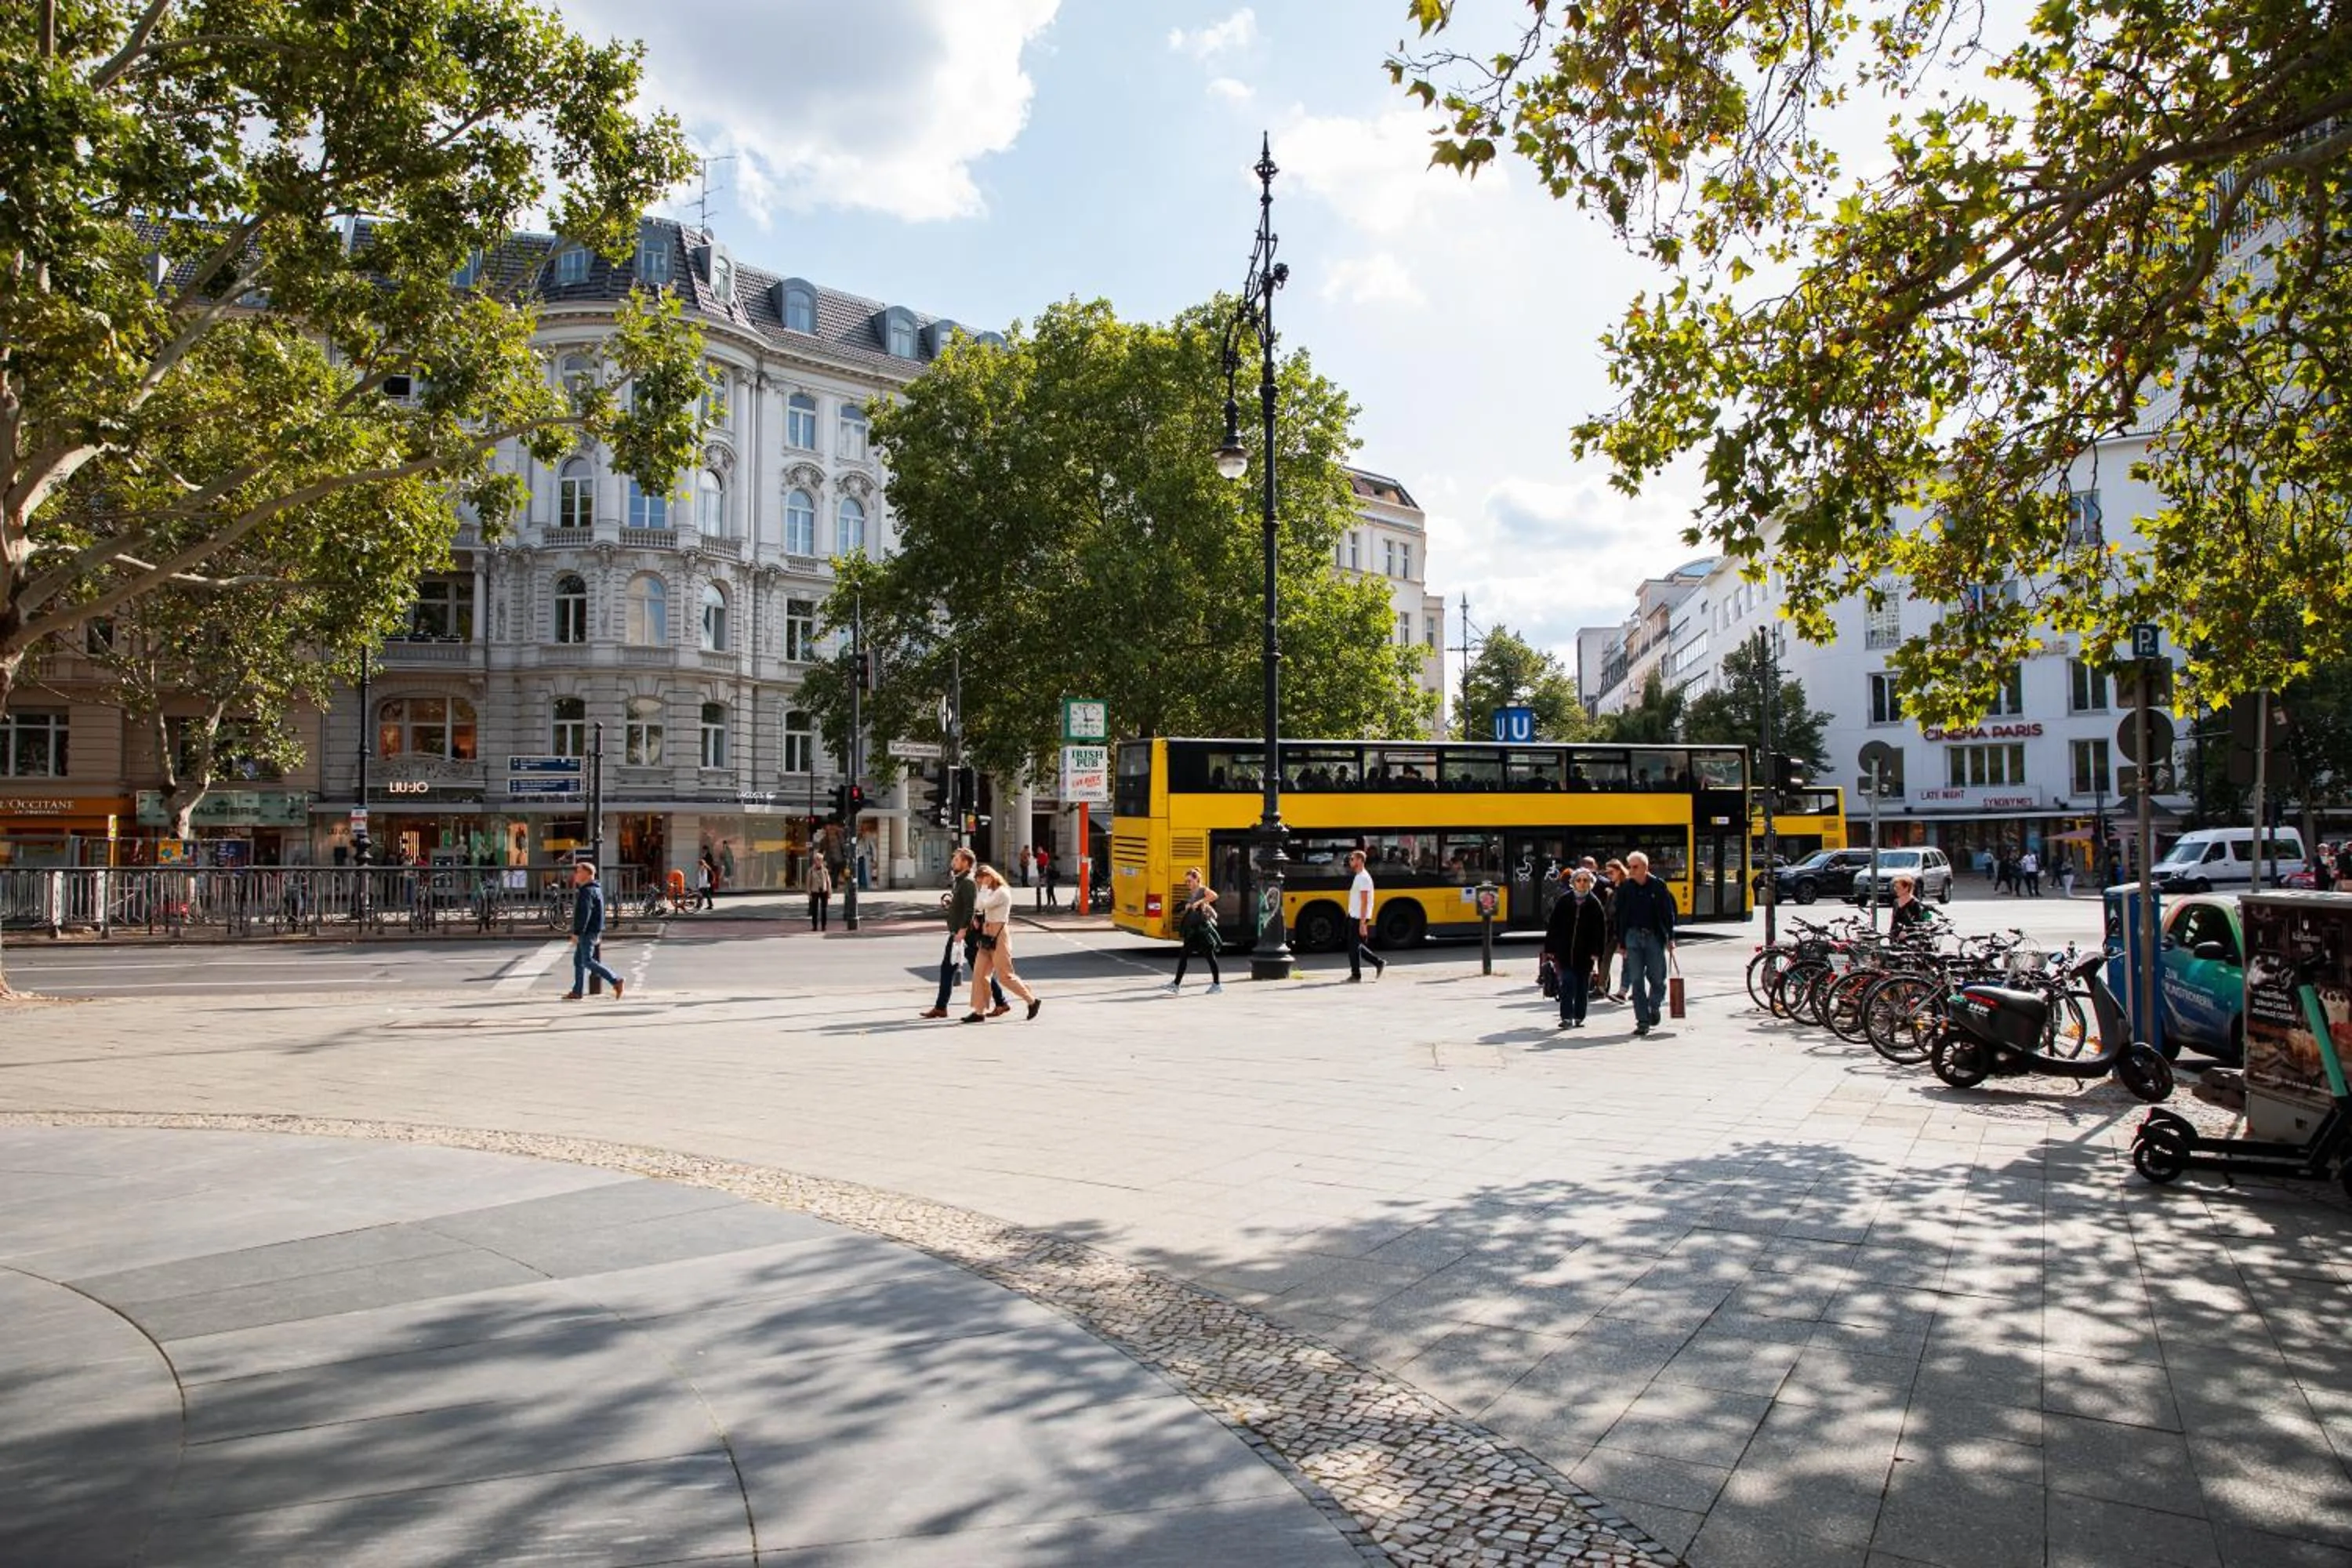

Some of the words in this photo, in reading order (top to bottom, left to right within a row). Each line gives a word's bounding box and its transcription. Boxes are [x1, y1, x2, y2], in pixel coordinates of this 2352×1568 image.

[2138, 628, 2152, 653] P
[1496, 717, 1505, 741] U
[1512, 717, 1528, 741] U
[1923, 726, 1987, 741] CINEMA
[1992, 723, 2043, 738] PARIS
[1072, 750, 1103, 759] IRISH
[1921, 791, 1939, 800] LATE
[1943, 789, 1965, 799] NIGHT
[1983, 797, 2033, 807] SYNONYMES
[194, 807, 262, 815] ALMERS
